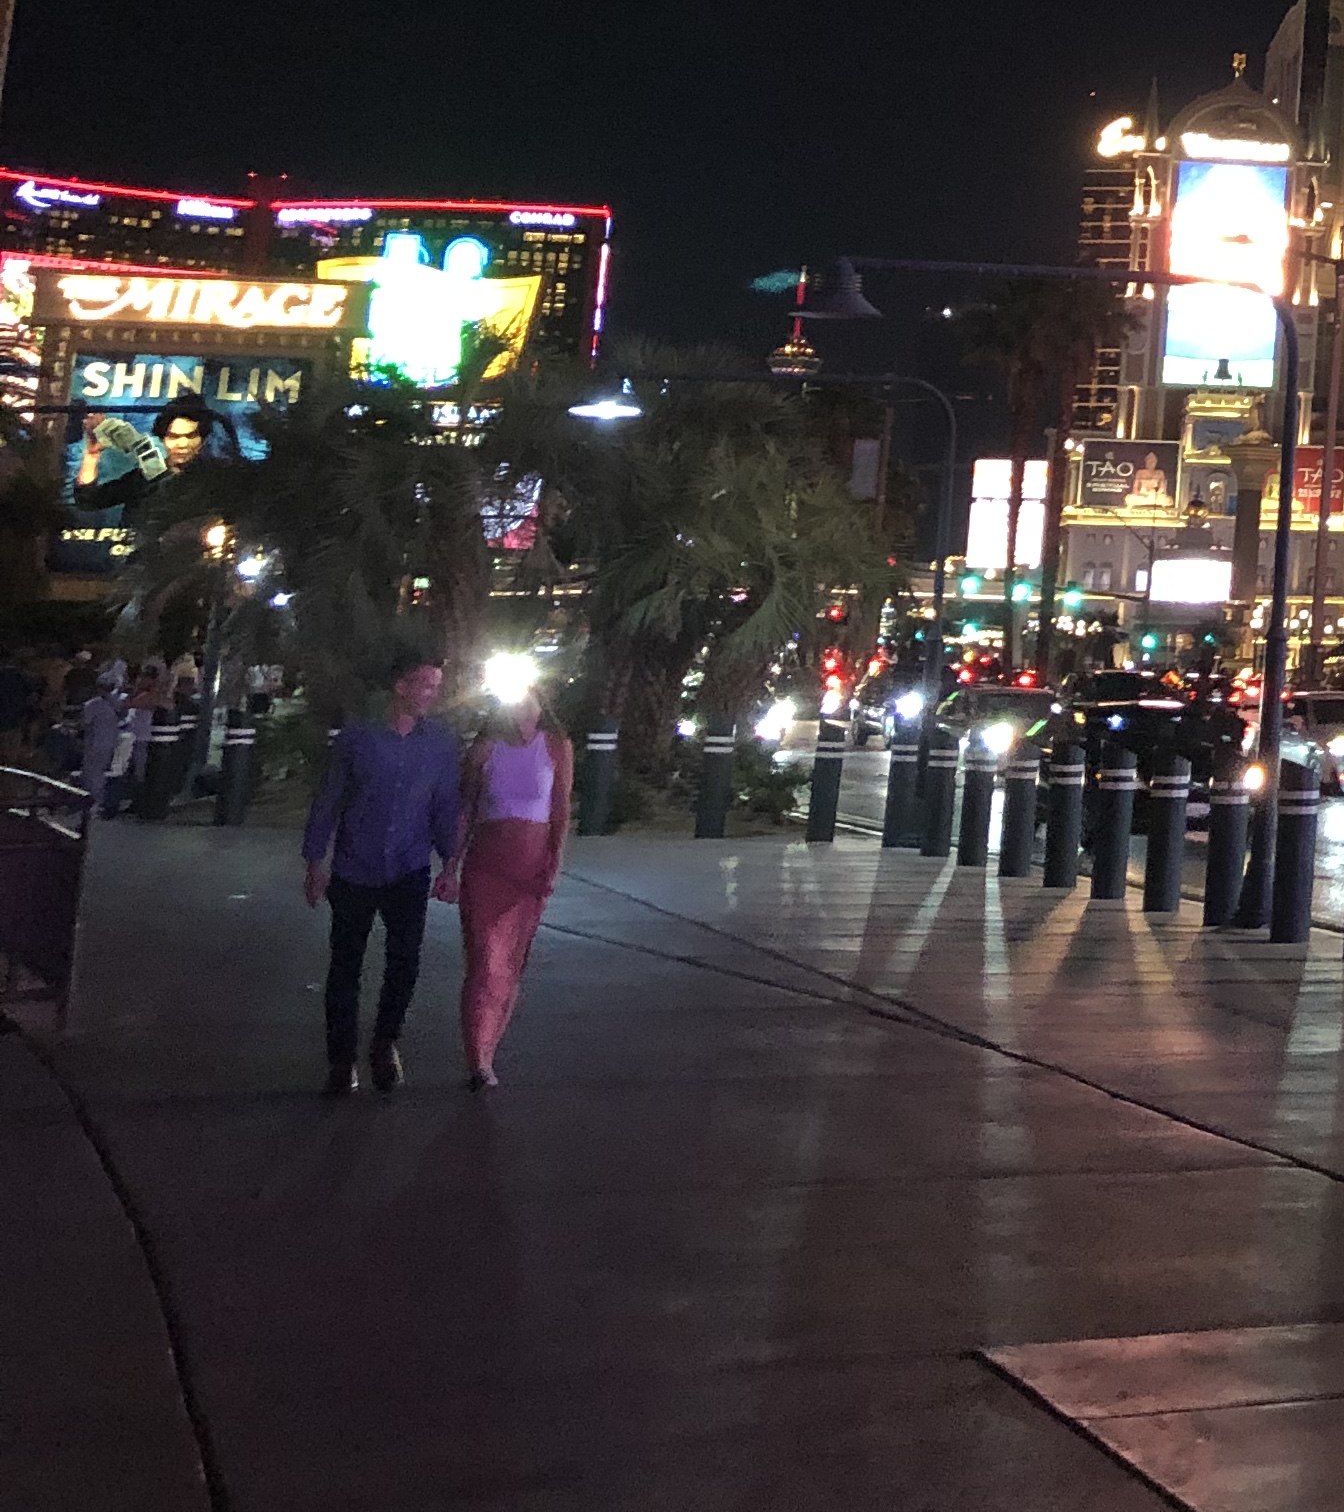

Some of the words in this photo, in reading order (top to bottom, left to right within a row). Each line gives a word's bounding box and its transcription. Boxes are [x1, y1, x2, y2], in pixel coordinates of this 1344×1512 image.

[69, 278, 347, 327] MIRAGE
[82, 361, 203, 399] SHIN
[216, 366, 302, 404] LIM
[1086, 460, 1134, 477] TAO
